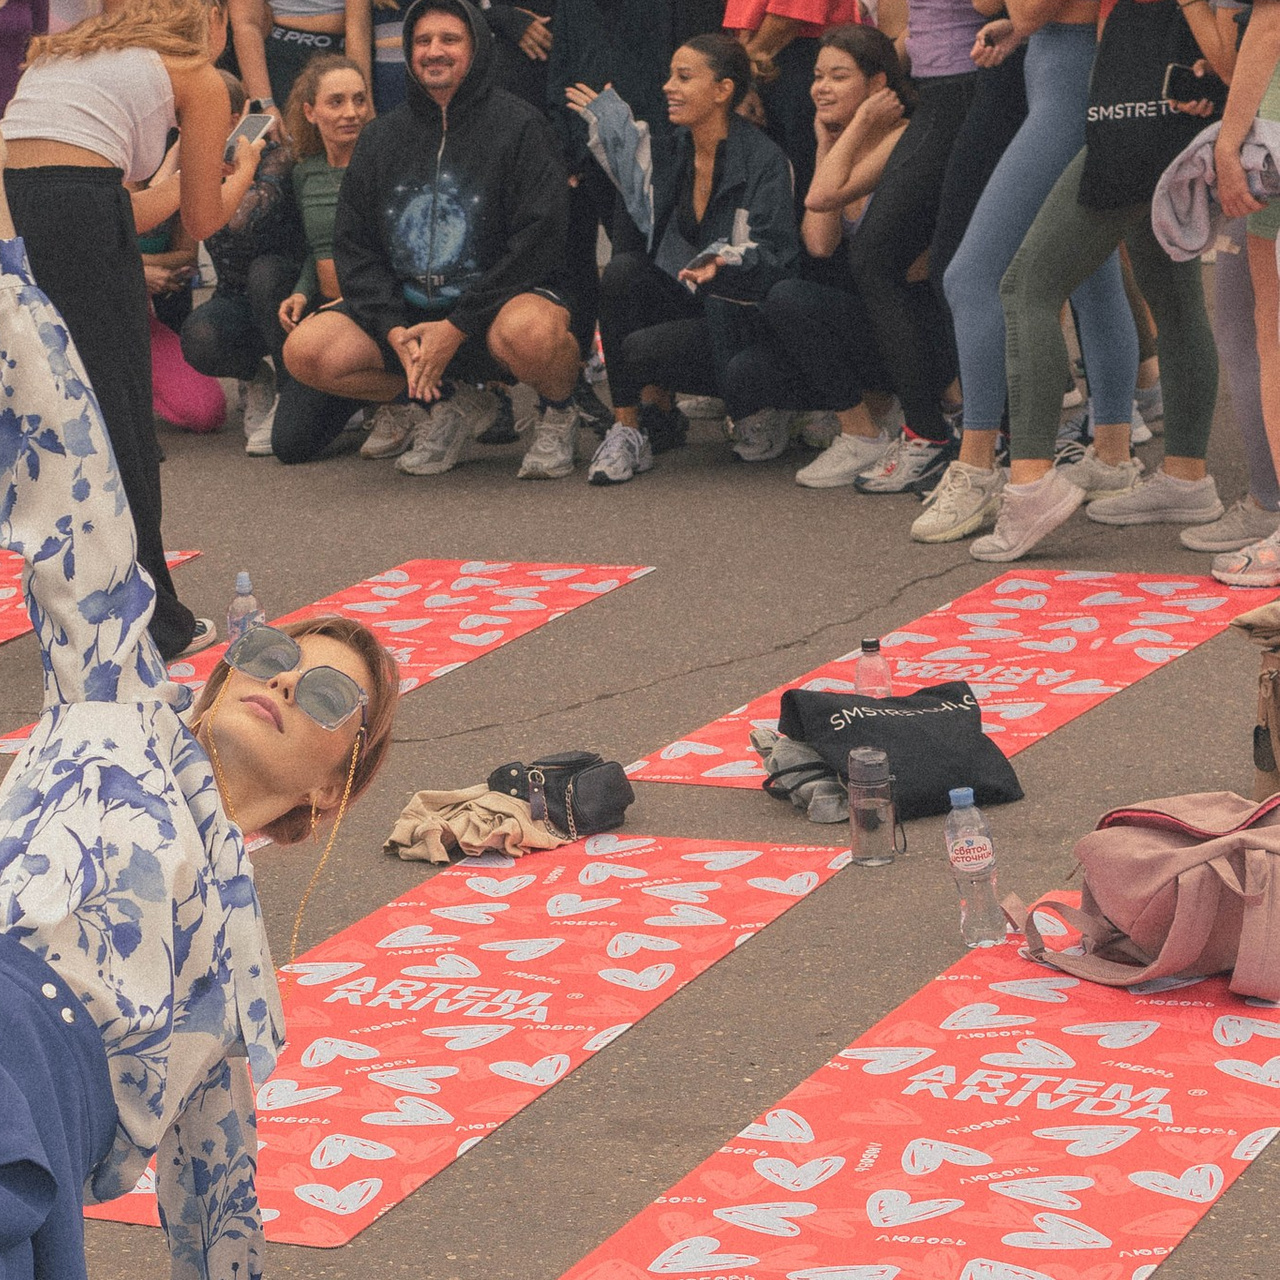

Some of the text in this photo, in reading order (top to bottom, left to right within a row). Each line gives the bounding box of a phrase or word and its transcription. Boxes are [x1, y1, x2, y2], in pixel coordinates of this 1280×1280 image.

[1087, 100, 1181, 122] SMSTRET
[332, 977, 552, 1007] ARTEM
[323, 990, 548, 1022] KRIVDA
[957, 1030, 1034, 1039] ЛЮБОВЬ
[1102, 1061, 1173, 1078] ЛЮБОВЬ
[908, 1065, 1171, 1103] ARTEM
[901, 1080, 1174, 1124] KRIVDA
[1150, 1126, 1236, 1135] ЛЮБОВЬ
[719, 1146, 768, 1156] БОВЬ
[960, 1167, 1038, 1184] ЛЮБОВЬ
[876, 1235, 966, 1245] ЛЮБОВЬ
[1120, 1247, 1173, 1257] ЛЮБ
